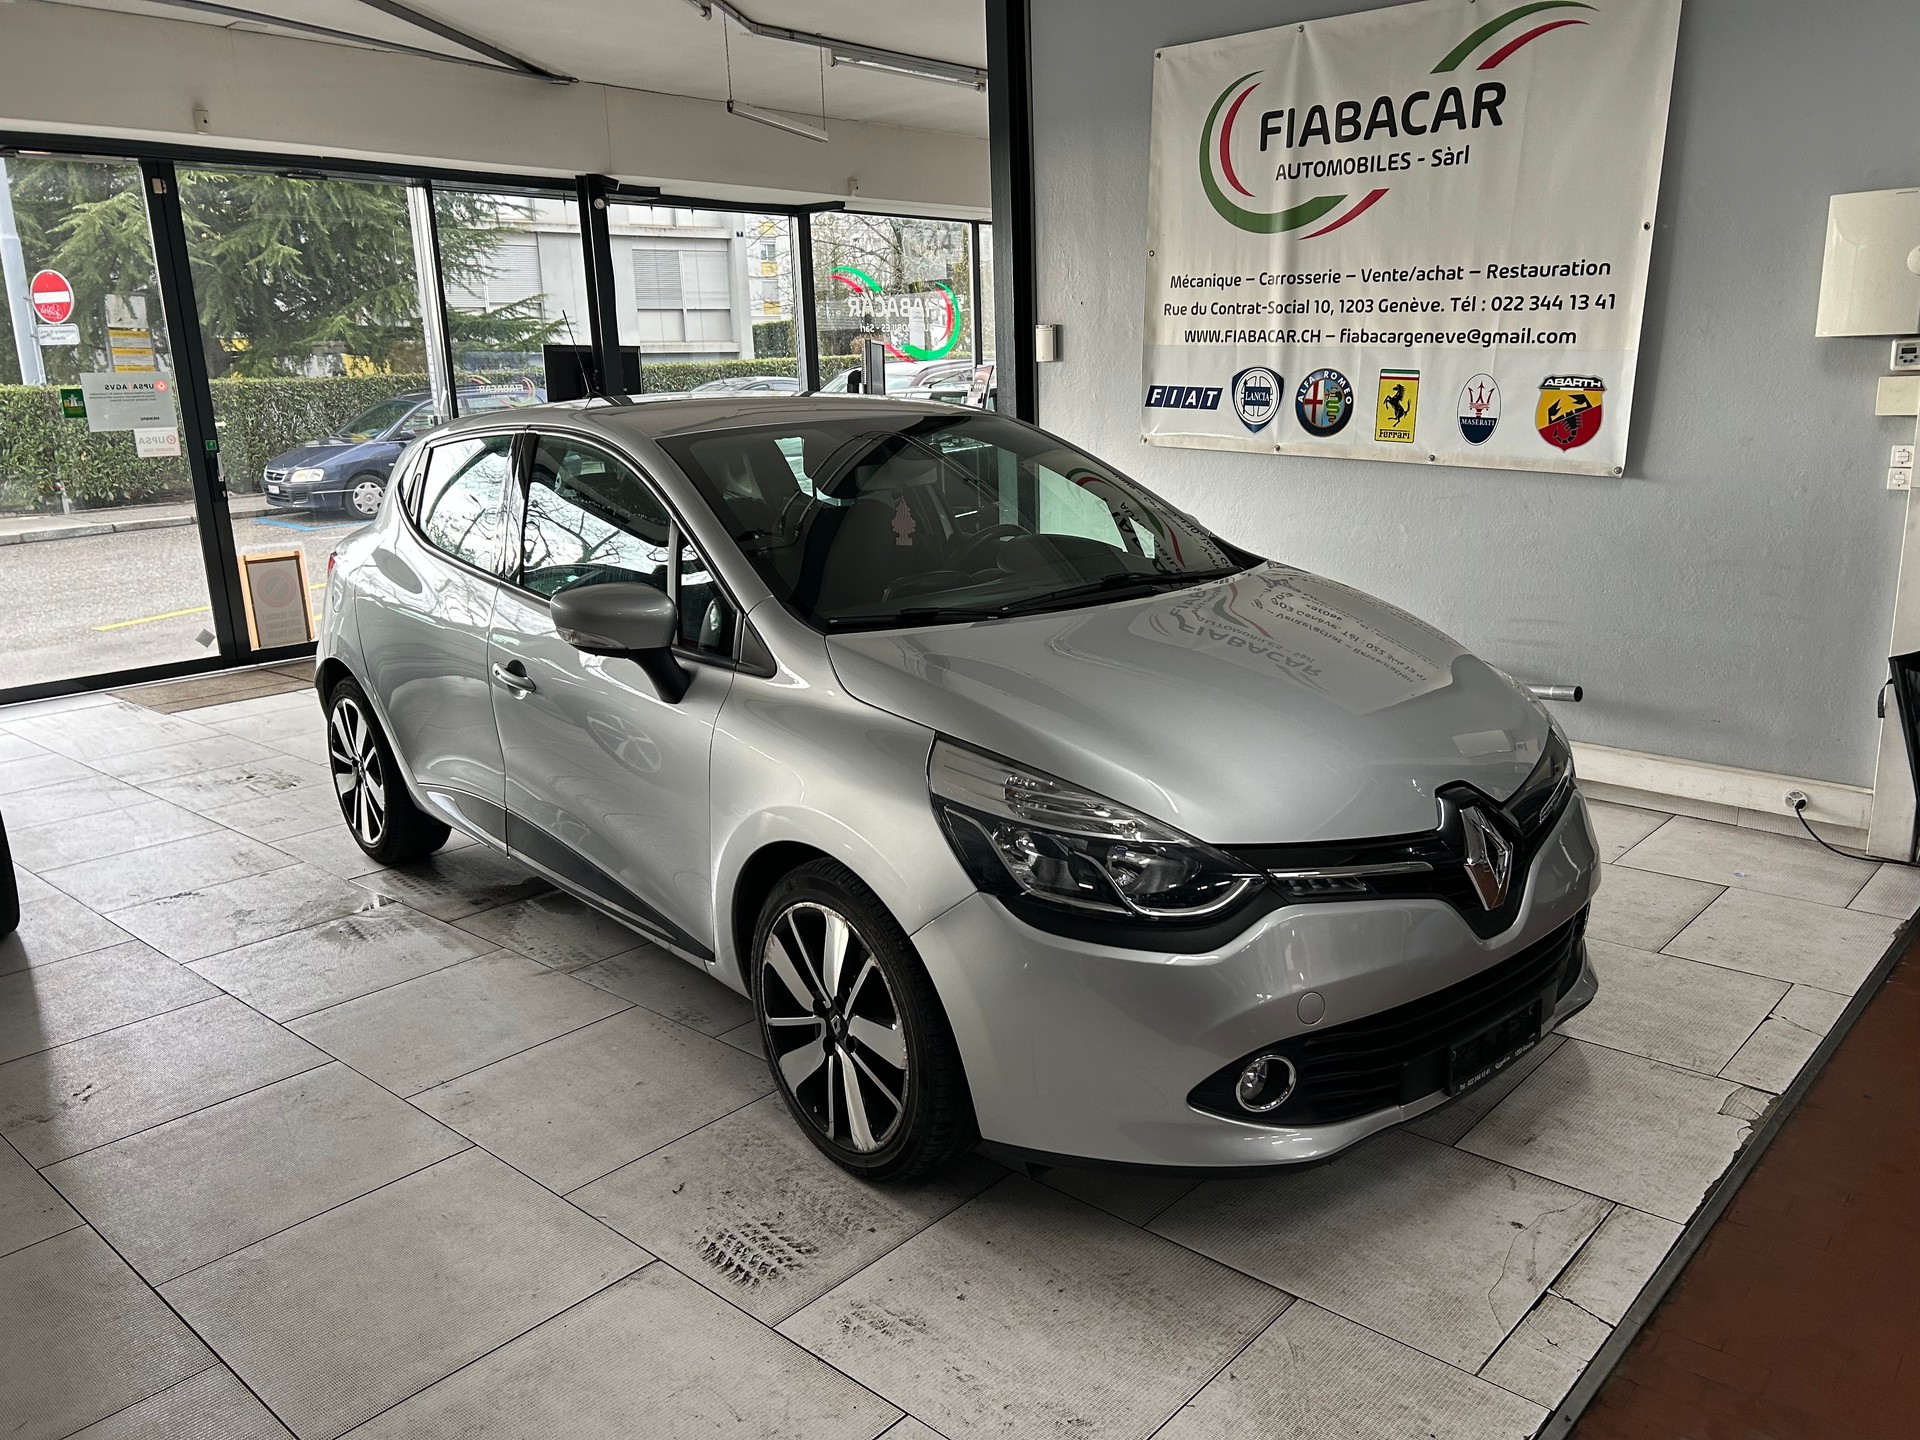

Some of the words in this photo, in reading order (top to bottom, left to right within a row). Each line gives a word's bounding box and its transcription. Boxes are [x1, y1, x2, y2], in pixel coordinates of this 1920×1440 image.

[1259, 82, 1507, 152] FIABACAR
[1275, 151, 1411, 181] AUTOMOBILES
[1431, 144, 1470, 167] Sàrl
[1170, 273, 1242, 291] Mécanique
[1259, 268, 1342, 286] Carrosserie
[1361, 264, 1465, 283] Vente/achat
[1486, 258, 1612, 280] Restauration
[1163, 303, 1188, 316] Rue
[1190, 301, 1207, 316] du
[1210, 298, 1310, 316] Contrat-Social
[1314, 299, 1335, 317] 10,
[1339, 298, 1374, 314] 1203
[1378, 297, 1445, 313] Genève.
[1450, 295, 1477, 313] Tél
[1490, 295, 1524, 312] 022
[1528, 294, 1564, 311] 344
[1570, 294, 1590, 311] 13
[1594, 293, 1616, 310] 41
[1184, 328, 1322, 344] WWW.FIABACAR.CH
[1339, 327, 1578, 348] fiabacargeneve@gmail.com
[1297, 376, 1316, 403] ALFA
[1323, 370, 1353, 405] ROMEO
[1543, 377, 1602, 388] ABARTH
[1150, 388, 1219, 408] FIAT
[1245, 391, 1270, 402] LANCIA
[1460, 418, 1495, 427] MASERATI
[1378, 429, 1411, 440] Ferrari
